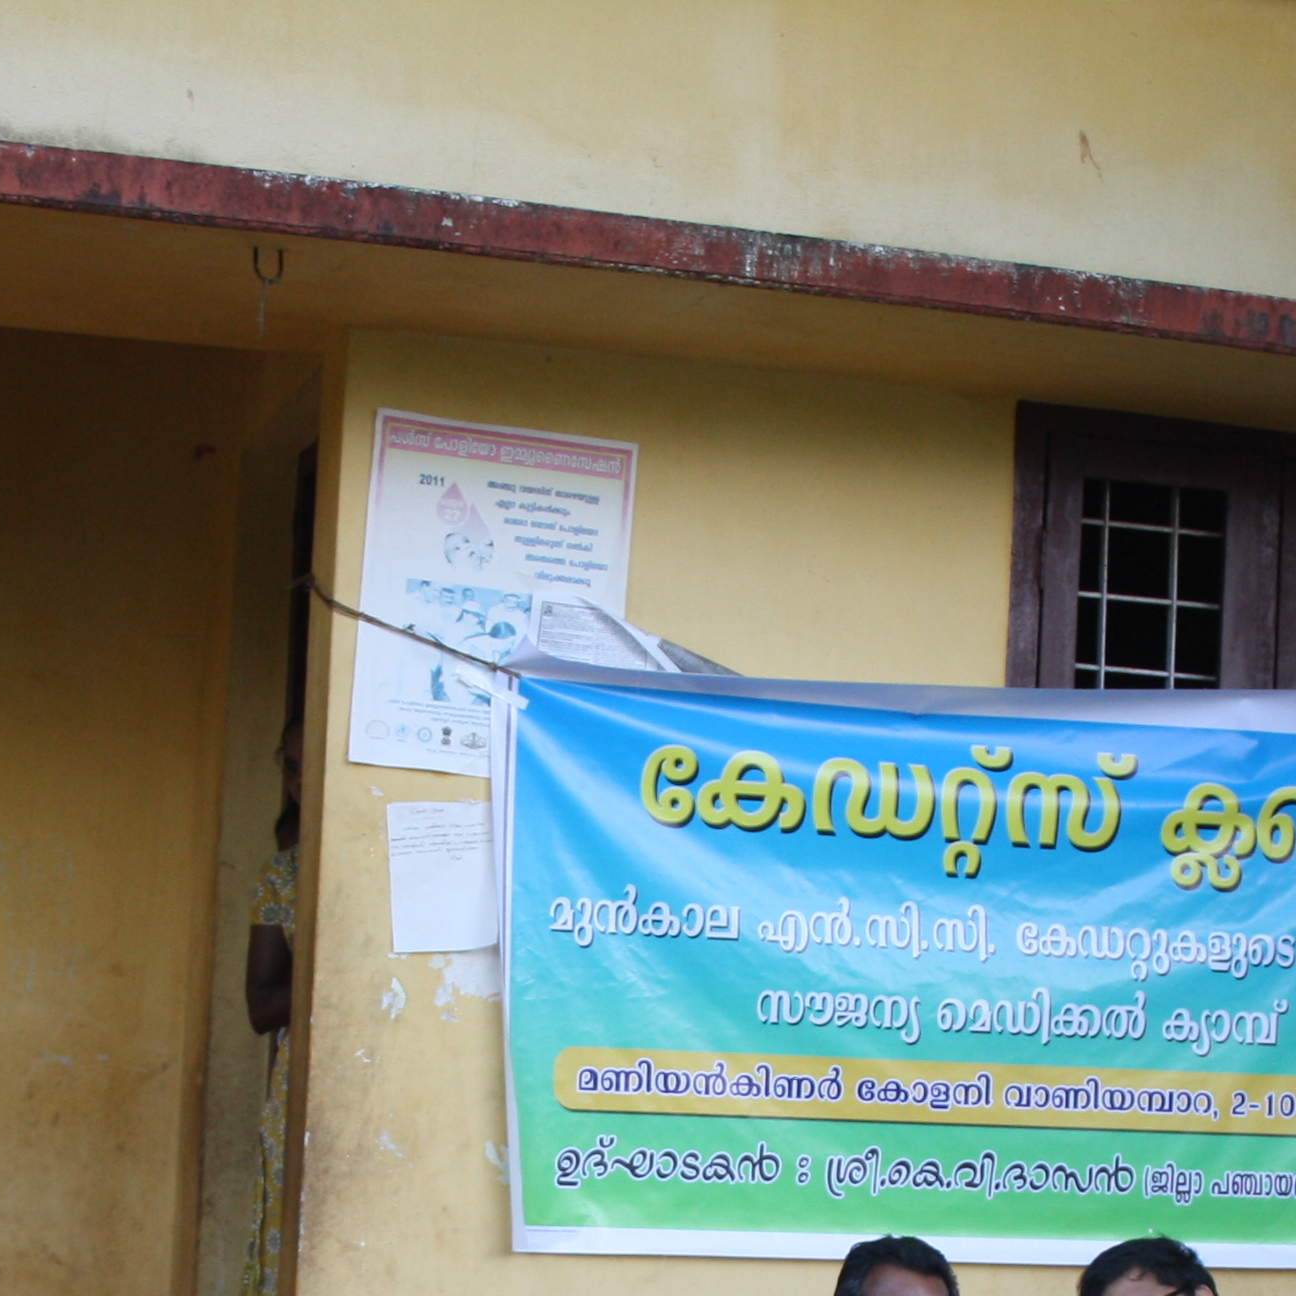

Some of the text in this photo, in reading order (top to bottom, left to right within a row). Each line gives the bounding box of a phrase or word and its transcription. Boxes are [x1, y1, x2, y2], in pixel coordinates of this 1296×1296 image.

[419, 473, 445, 487] 2011
[434, 436, 497, 459] പോളിയോ
[641, 745, 1138, 878] കേഡറ്റ്സ്
[549, 884, 741, 947] മുൻകാല
[758, 896, 996, 962] എൻ.സി.സി.
[1016, 922, 1296, 981] കേഡറ്റുകളുടെ
[756, 987, 1289, 1057] സൗജന്യ മെഡിക്കൽ ക്യാമ്പ്
[577, 1057, 844, 1103] മണിയൻകിണർ
[856, 1072, 993, 1112] കോളനി
[1003, 1075, 1219, 1122] വാണിയമ്പാറ,
[556, 1134, 782, 1189] ഉദ്ഘാടകൻ
[1144, 1161, 1203, 1206] (ജില്ലാ
